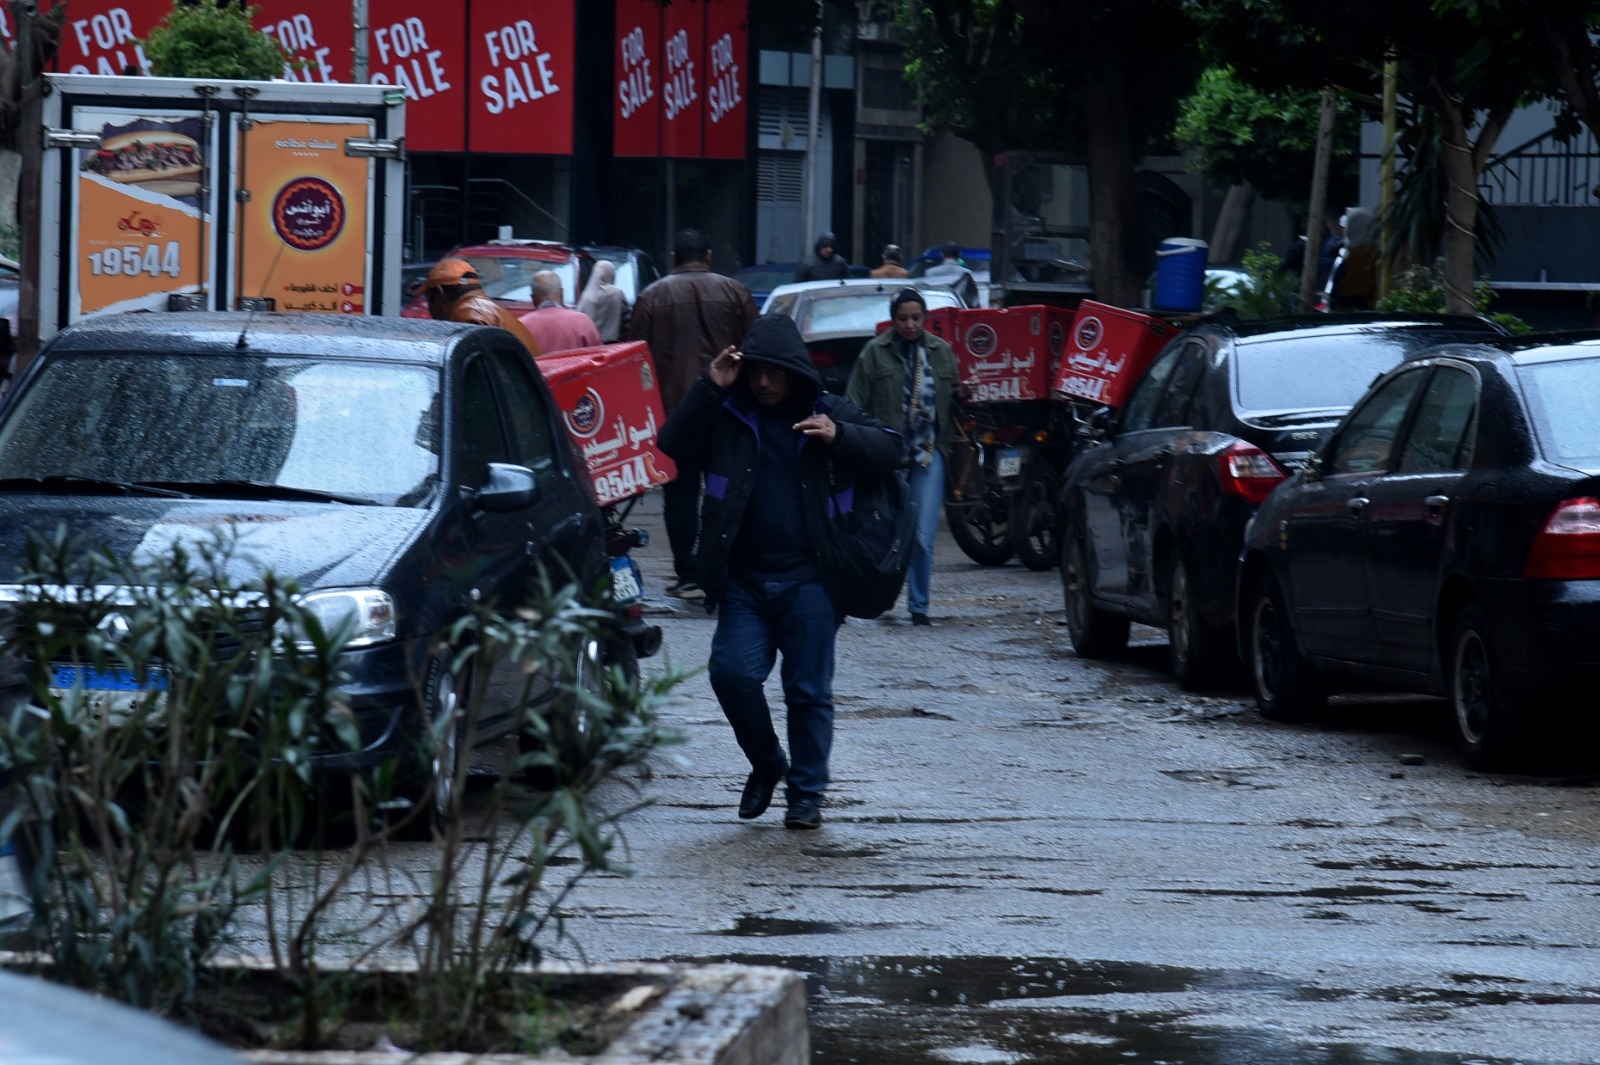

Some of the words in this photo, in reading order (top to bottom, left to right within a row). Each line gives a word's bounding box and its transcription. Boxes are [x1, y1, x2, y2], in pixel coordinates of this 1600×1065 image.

[72, 7, 137, 57] FOR
[374, 17, 430, 65] FOR
[484, 19, 539, 67] FOR
[621, 26, 646, 72] FOR
[666, 28, 689, 75] FOR
[711, 33, 734, 78] FOR
[69, 44, 153, 76] LE
[480, 52, 560, 115] SALE
[619, 58, 654, 119] SALE
[664, 60, 697, 120] SALE
[709, 64, 741, 123] SALE
[88, 241, 181, 278] 19544
[1061, 376, 1104, 400] 19544
[629, 405, 657, 450] أبو
[594, 456, 650, 502] 9544
